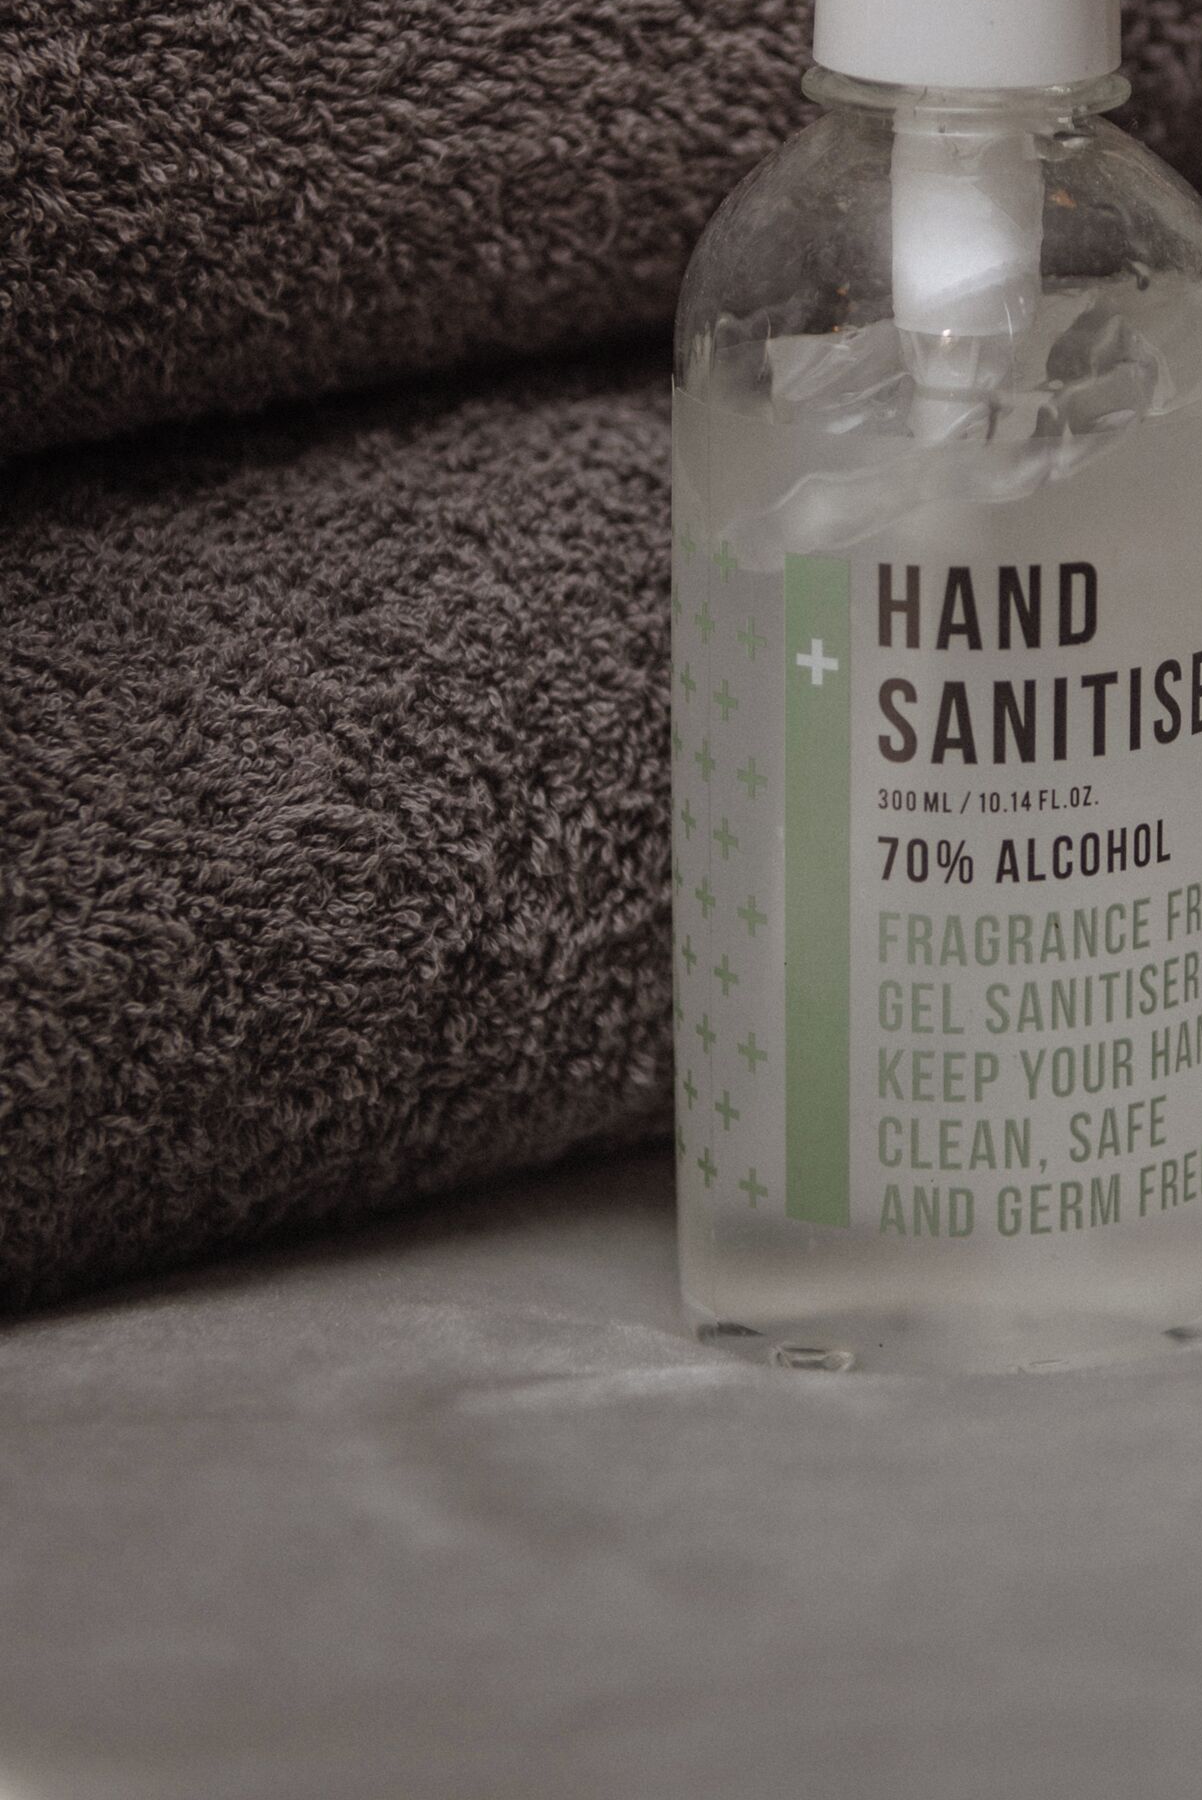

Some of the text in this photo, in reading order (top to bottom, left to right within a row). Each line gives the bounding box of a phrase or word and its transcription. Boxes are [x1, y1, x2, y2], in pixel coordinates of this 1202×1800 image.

[877, 561, 1098, 651] HAND
[960, 791, 971, 814] /
[877, 819, 1171, 884] 70% ALCOHOL
[877, 897, 1150, 966] FRAGRANCE
[877, 979, 965, 1034] GEL
[985, 950, 1199, 1033] SANITISER
[877, 1047, 998, 1102] KEEP
[1020, 1037, 1134, 1100] YOUR
[877, 1095, 1166, 1174] CLEAN, SAFE
[878, 1184, 975, 1238] AND
[997, 1172, 1121, 1237] GERM
